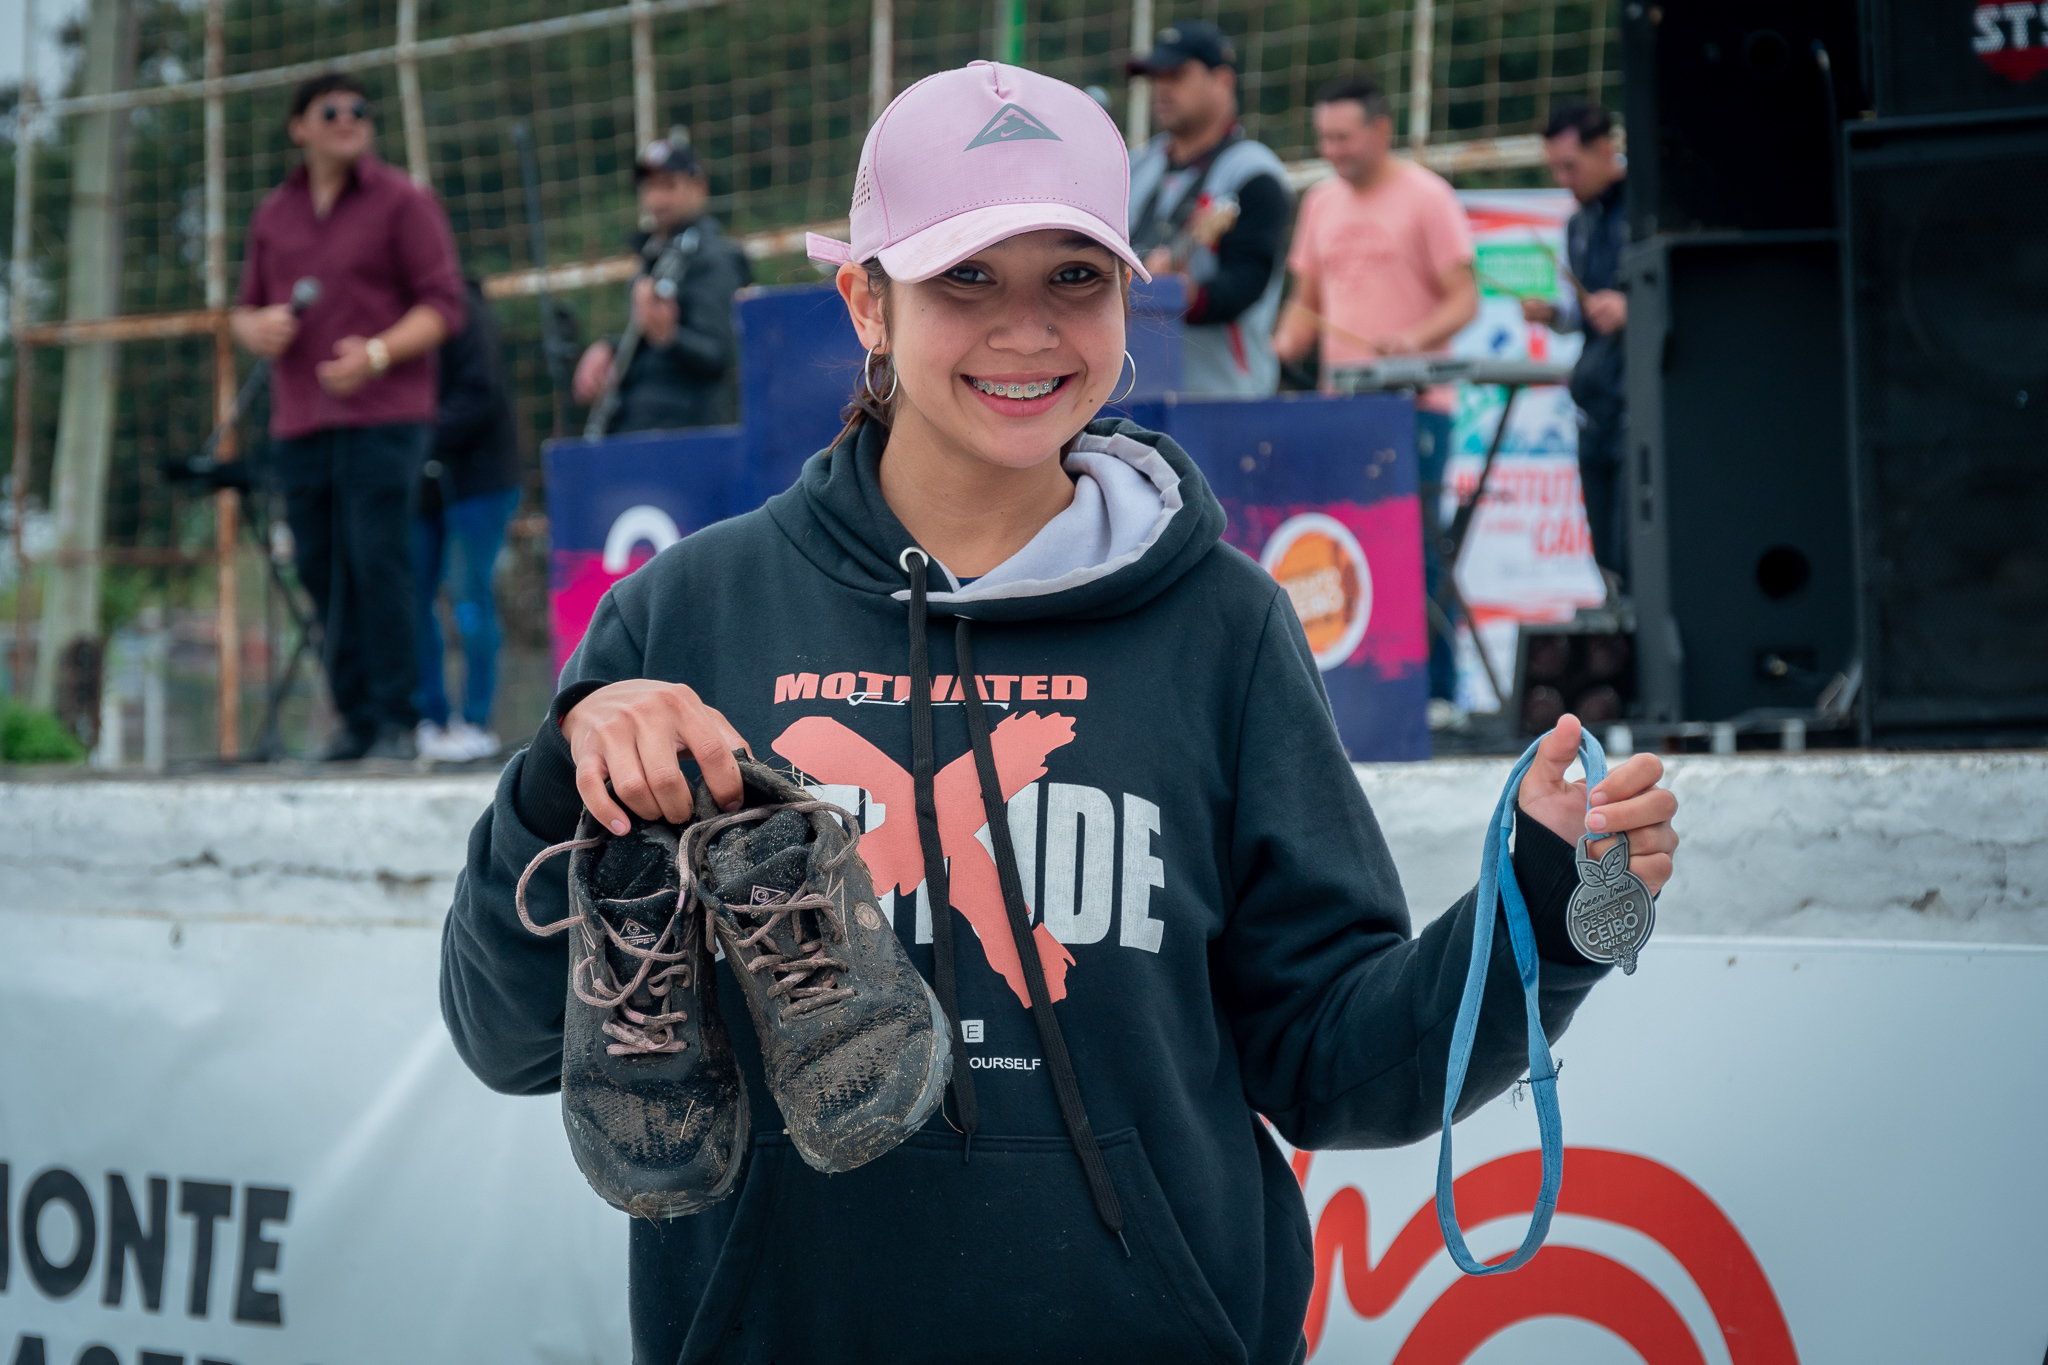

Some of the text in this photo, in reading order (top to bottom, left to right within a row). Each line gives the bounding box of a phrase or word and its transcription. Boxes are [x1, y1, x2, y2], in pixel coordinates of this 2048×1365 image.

[1971, 0, 2048, 54] ST
[774, 671, 1087, 704] MOTIVATED
[1574, 879, 1633, 914] Green Trail
[1586, 913, 1638, 946] CEIBO
[1600, 930, 1636, 951] TRAIL RUN
[969, 1057, 1041, 1070] OURSELF
[0, 1160, 291, 1326] ONTE
